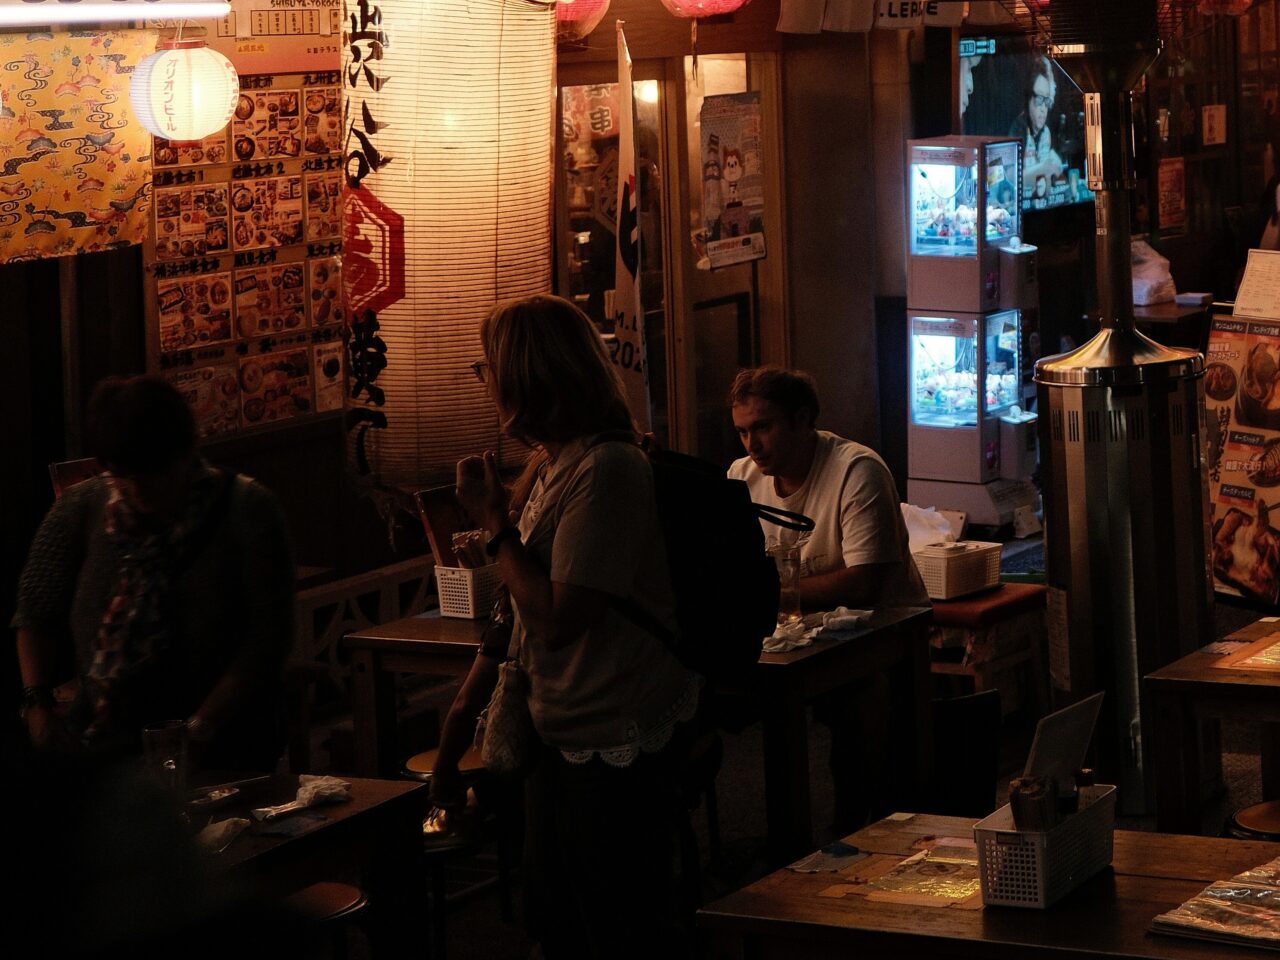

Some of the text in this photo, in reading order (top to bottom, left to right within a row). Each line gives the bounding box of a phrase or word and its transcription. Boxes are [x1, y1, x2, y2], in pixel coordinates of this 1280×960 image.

[163, 58, 178, 132] オリオンビール
